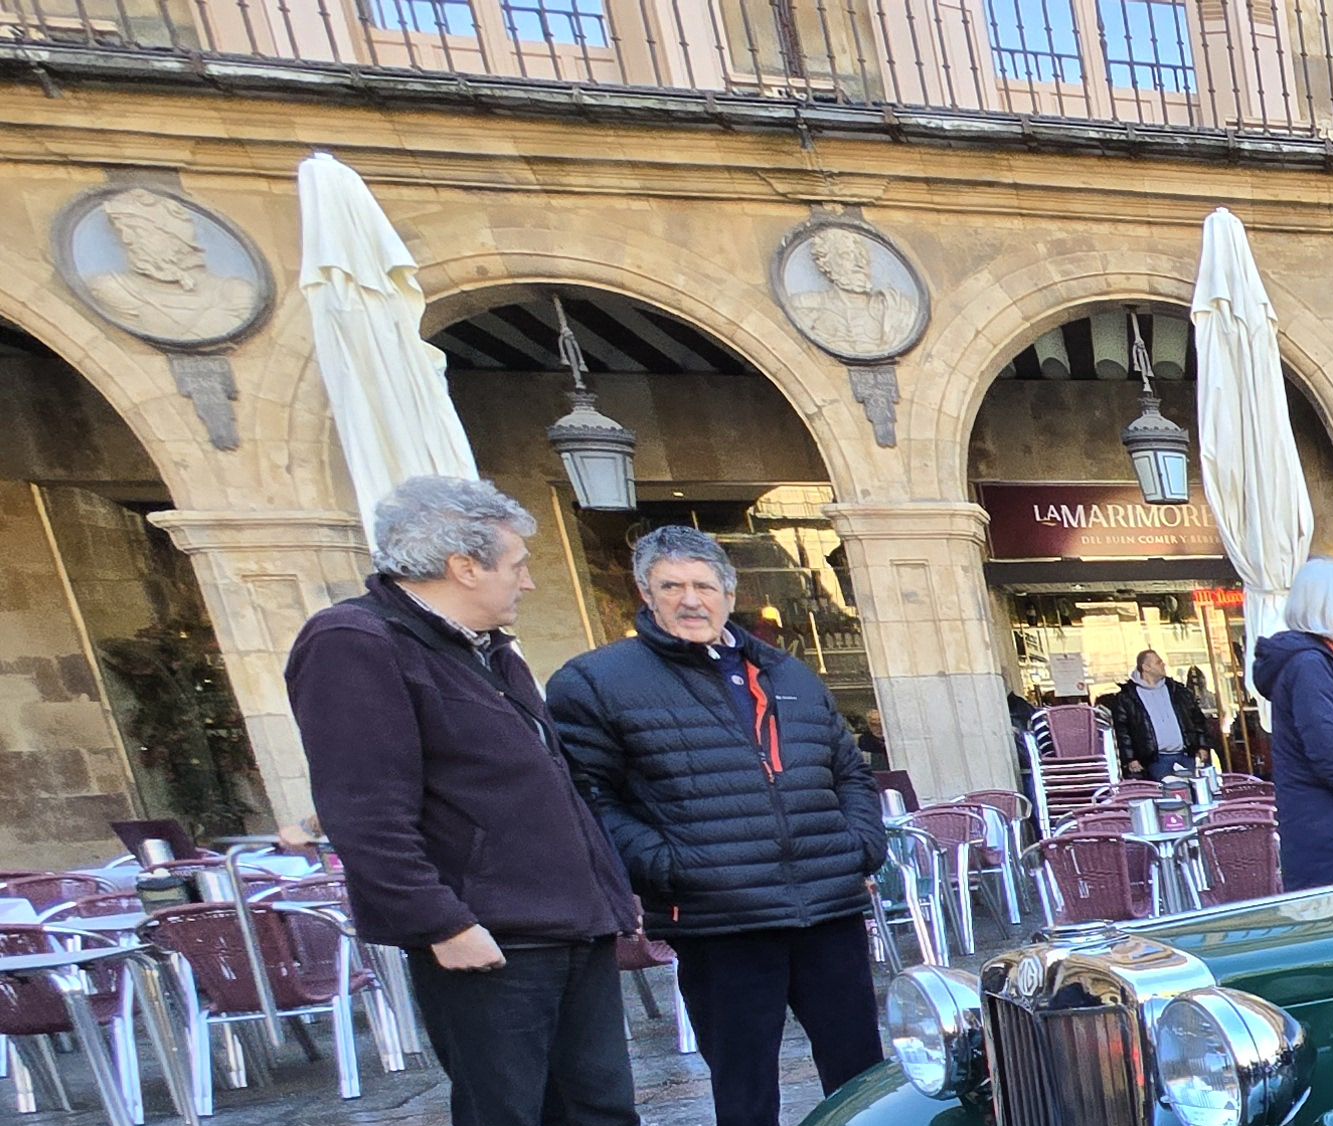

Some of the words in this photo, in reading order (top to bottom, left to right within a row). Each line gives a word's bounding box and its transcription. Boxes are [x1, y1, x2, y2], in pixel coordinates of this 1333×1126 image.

[1080, 536, 1102, 545] DEL
[1105, 536, 1135, 545] BUEN
[1138, 535, 1177, 545] COMER
[1179, 535, 1187, 544] Y
